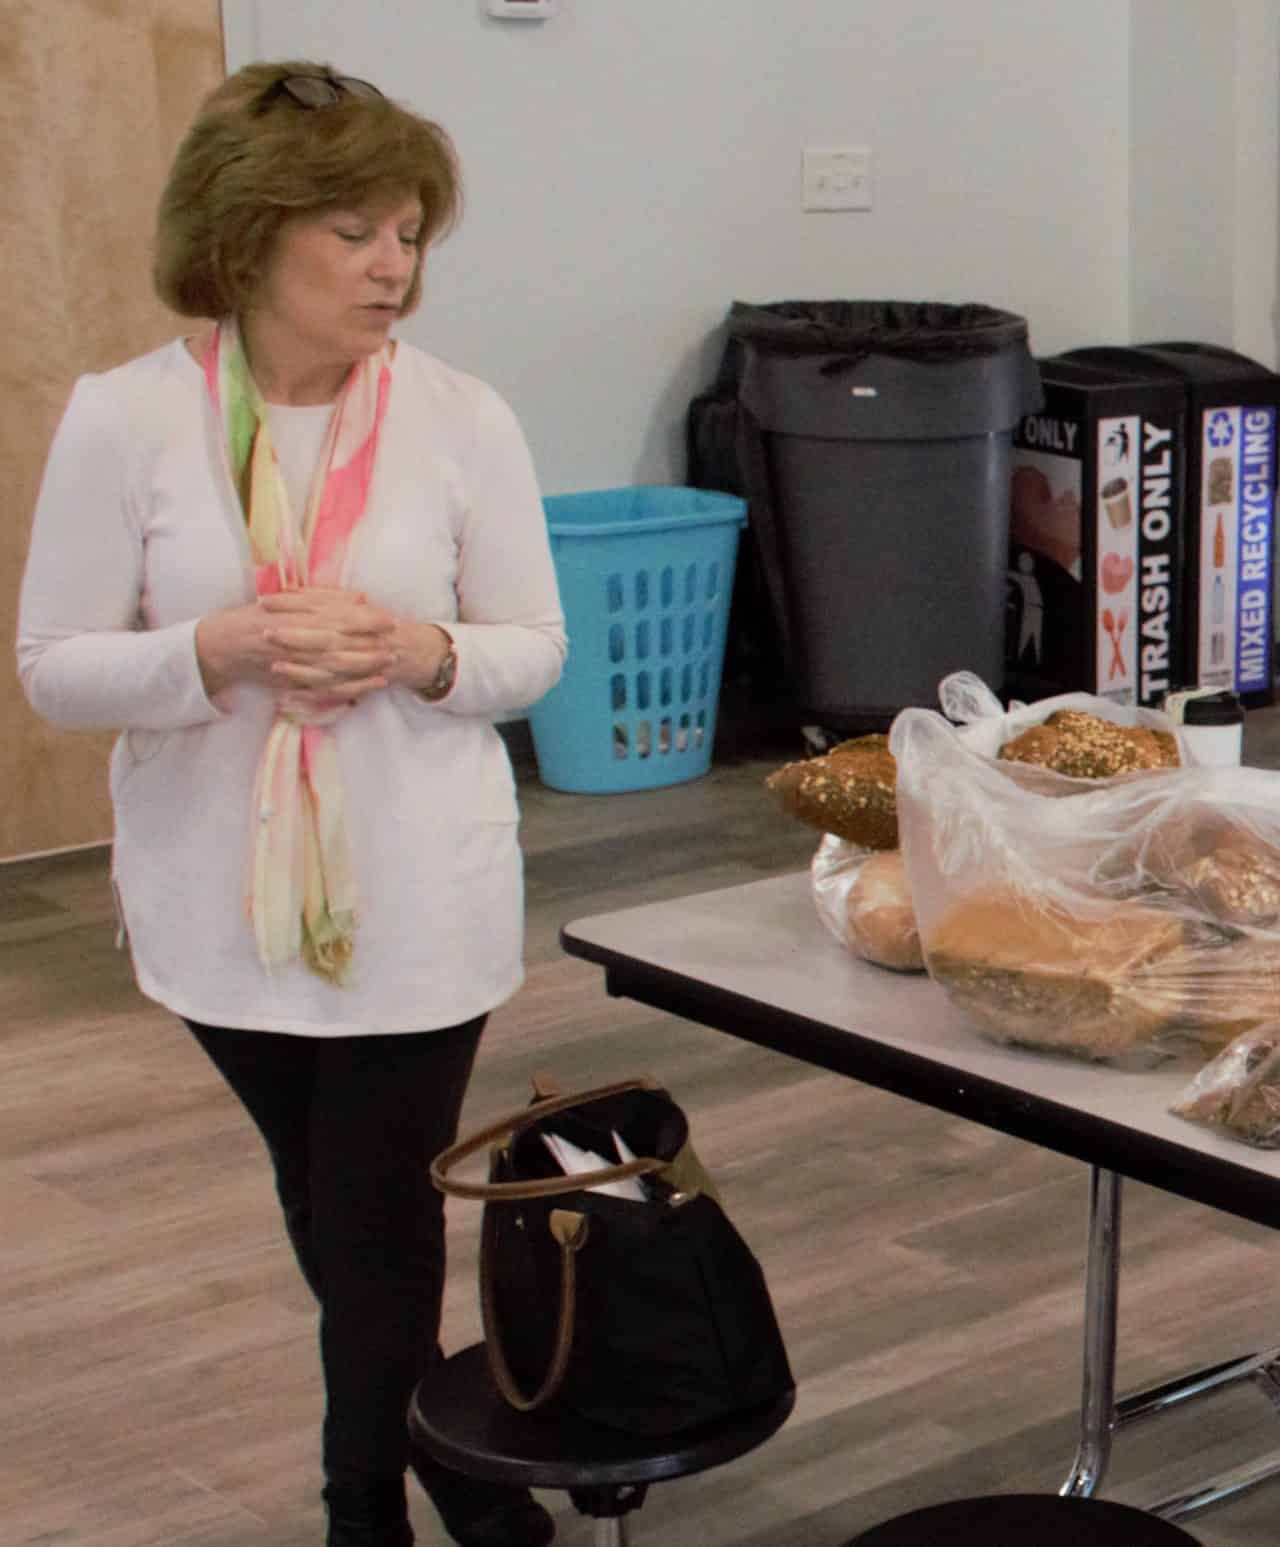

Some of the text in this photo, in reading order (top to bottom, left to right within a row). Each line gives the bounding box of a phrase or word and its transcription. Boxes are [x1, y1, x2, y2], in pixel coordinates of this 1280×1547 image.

[1024, 416, 1078, 452] ONLY
[1141, 422, 1173, 701] TRASH ONLY
[1239, 408, 1272, 684] MIXED RECYCLING
